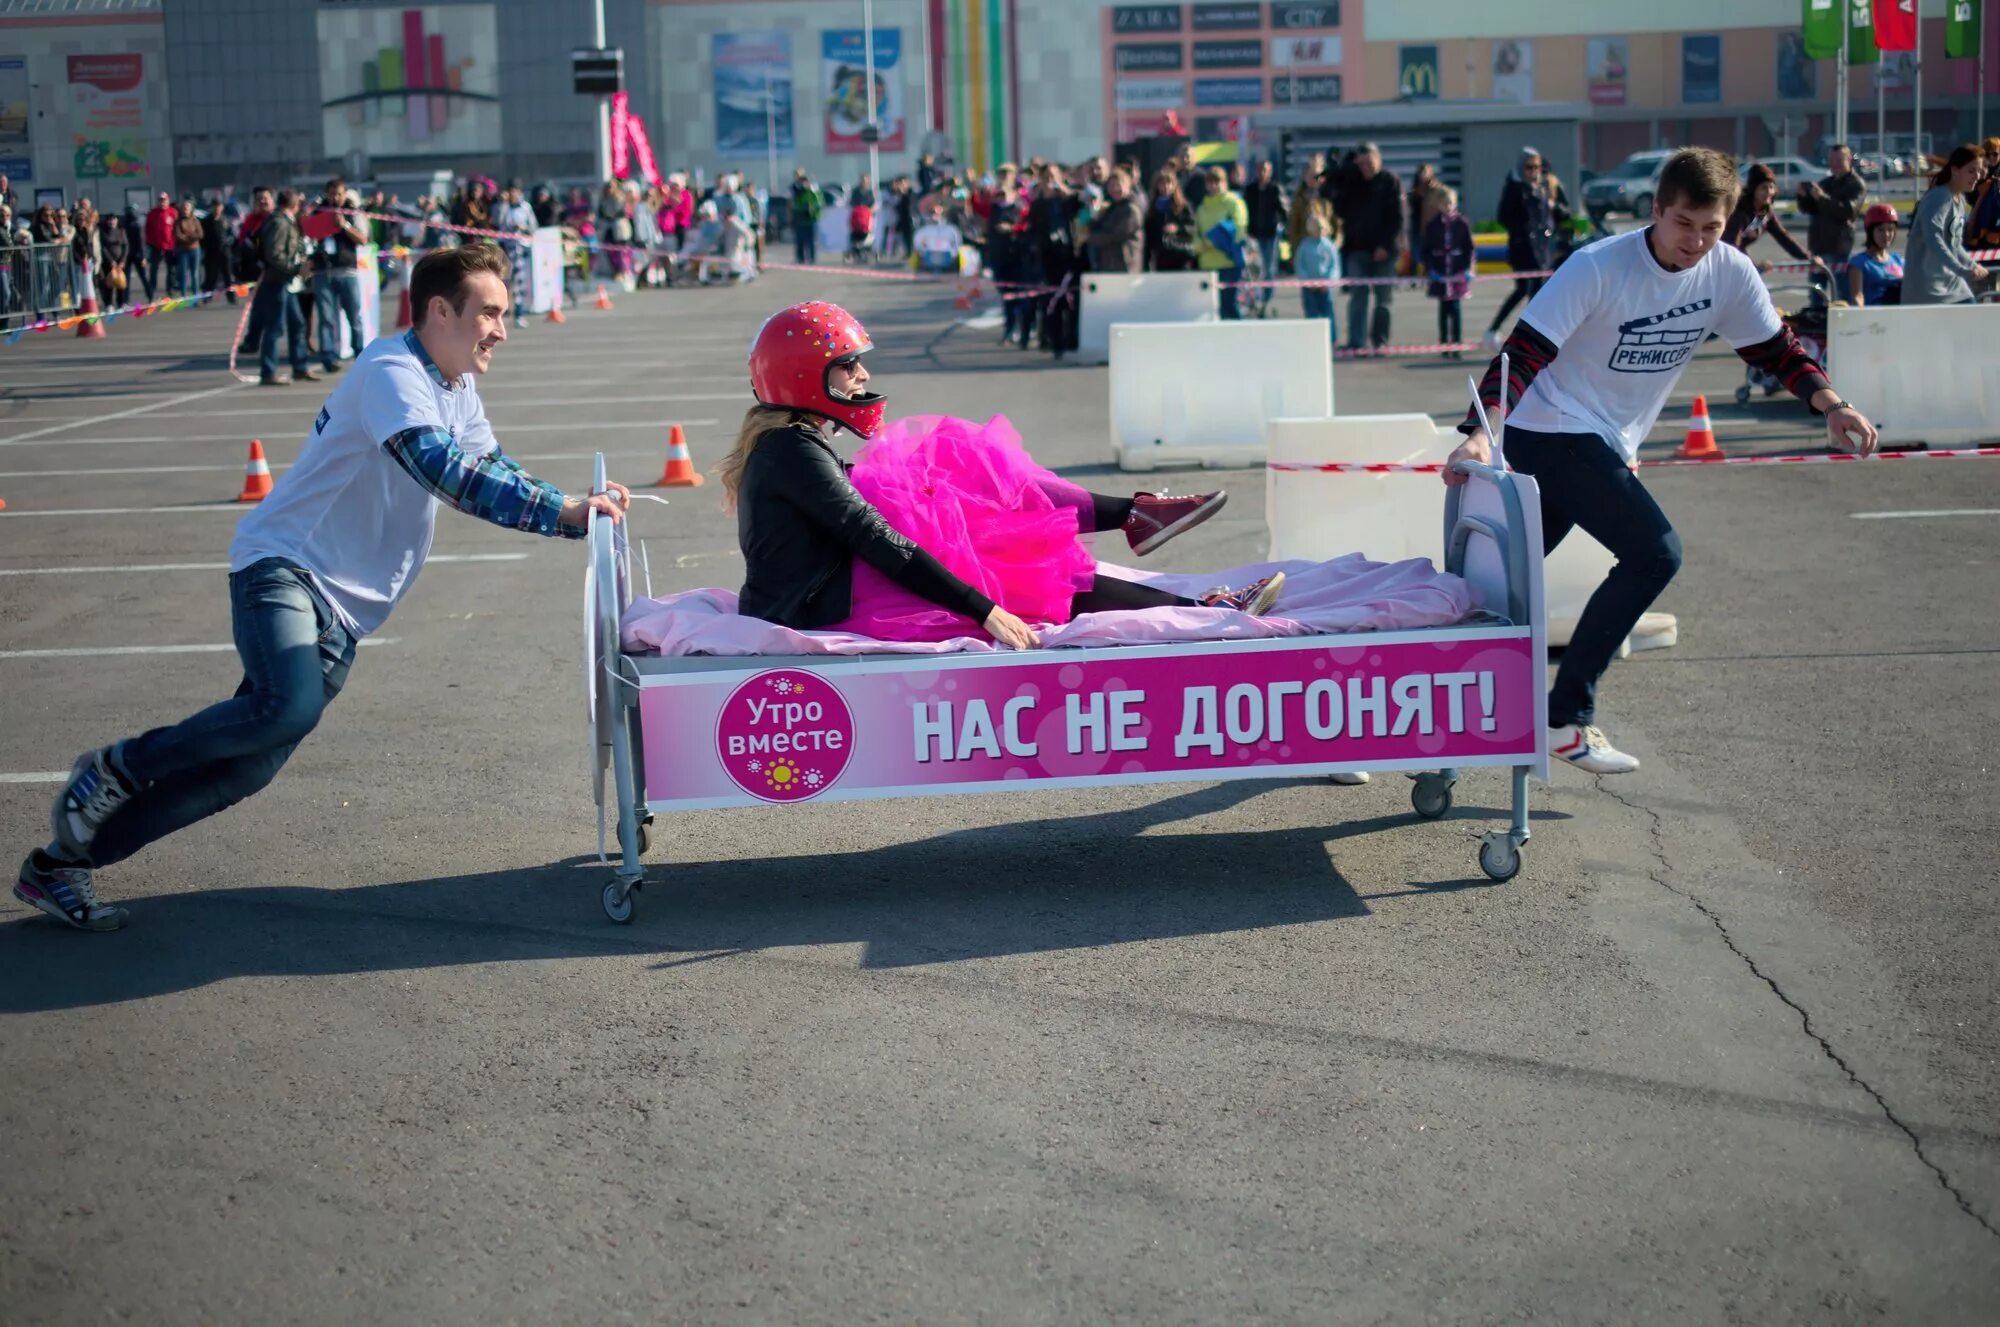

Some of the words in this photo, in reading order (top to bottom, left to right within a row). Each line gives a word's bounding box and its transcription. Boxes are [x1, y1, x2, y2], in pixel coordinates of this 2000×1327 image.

[1117, 10, 1179, 26] ZARA
[1284, 8, 1327, 28] CITY
[746, 697, 823, 730] Утро
[913, 696, 1038, 761] НАС
[1066, 690, 1148, 753] НЕ
[1174, 671, 1496, 757] ДОГОНЯТ!
[728, 729, 843, 755] вместе
